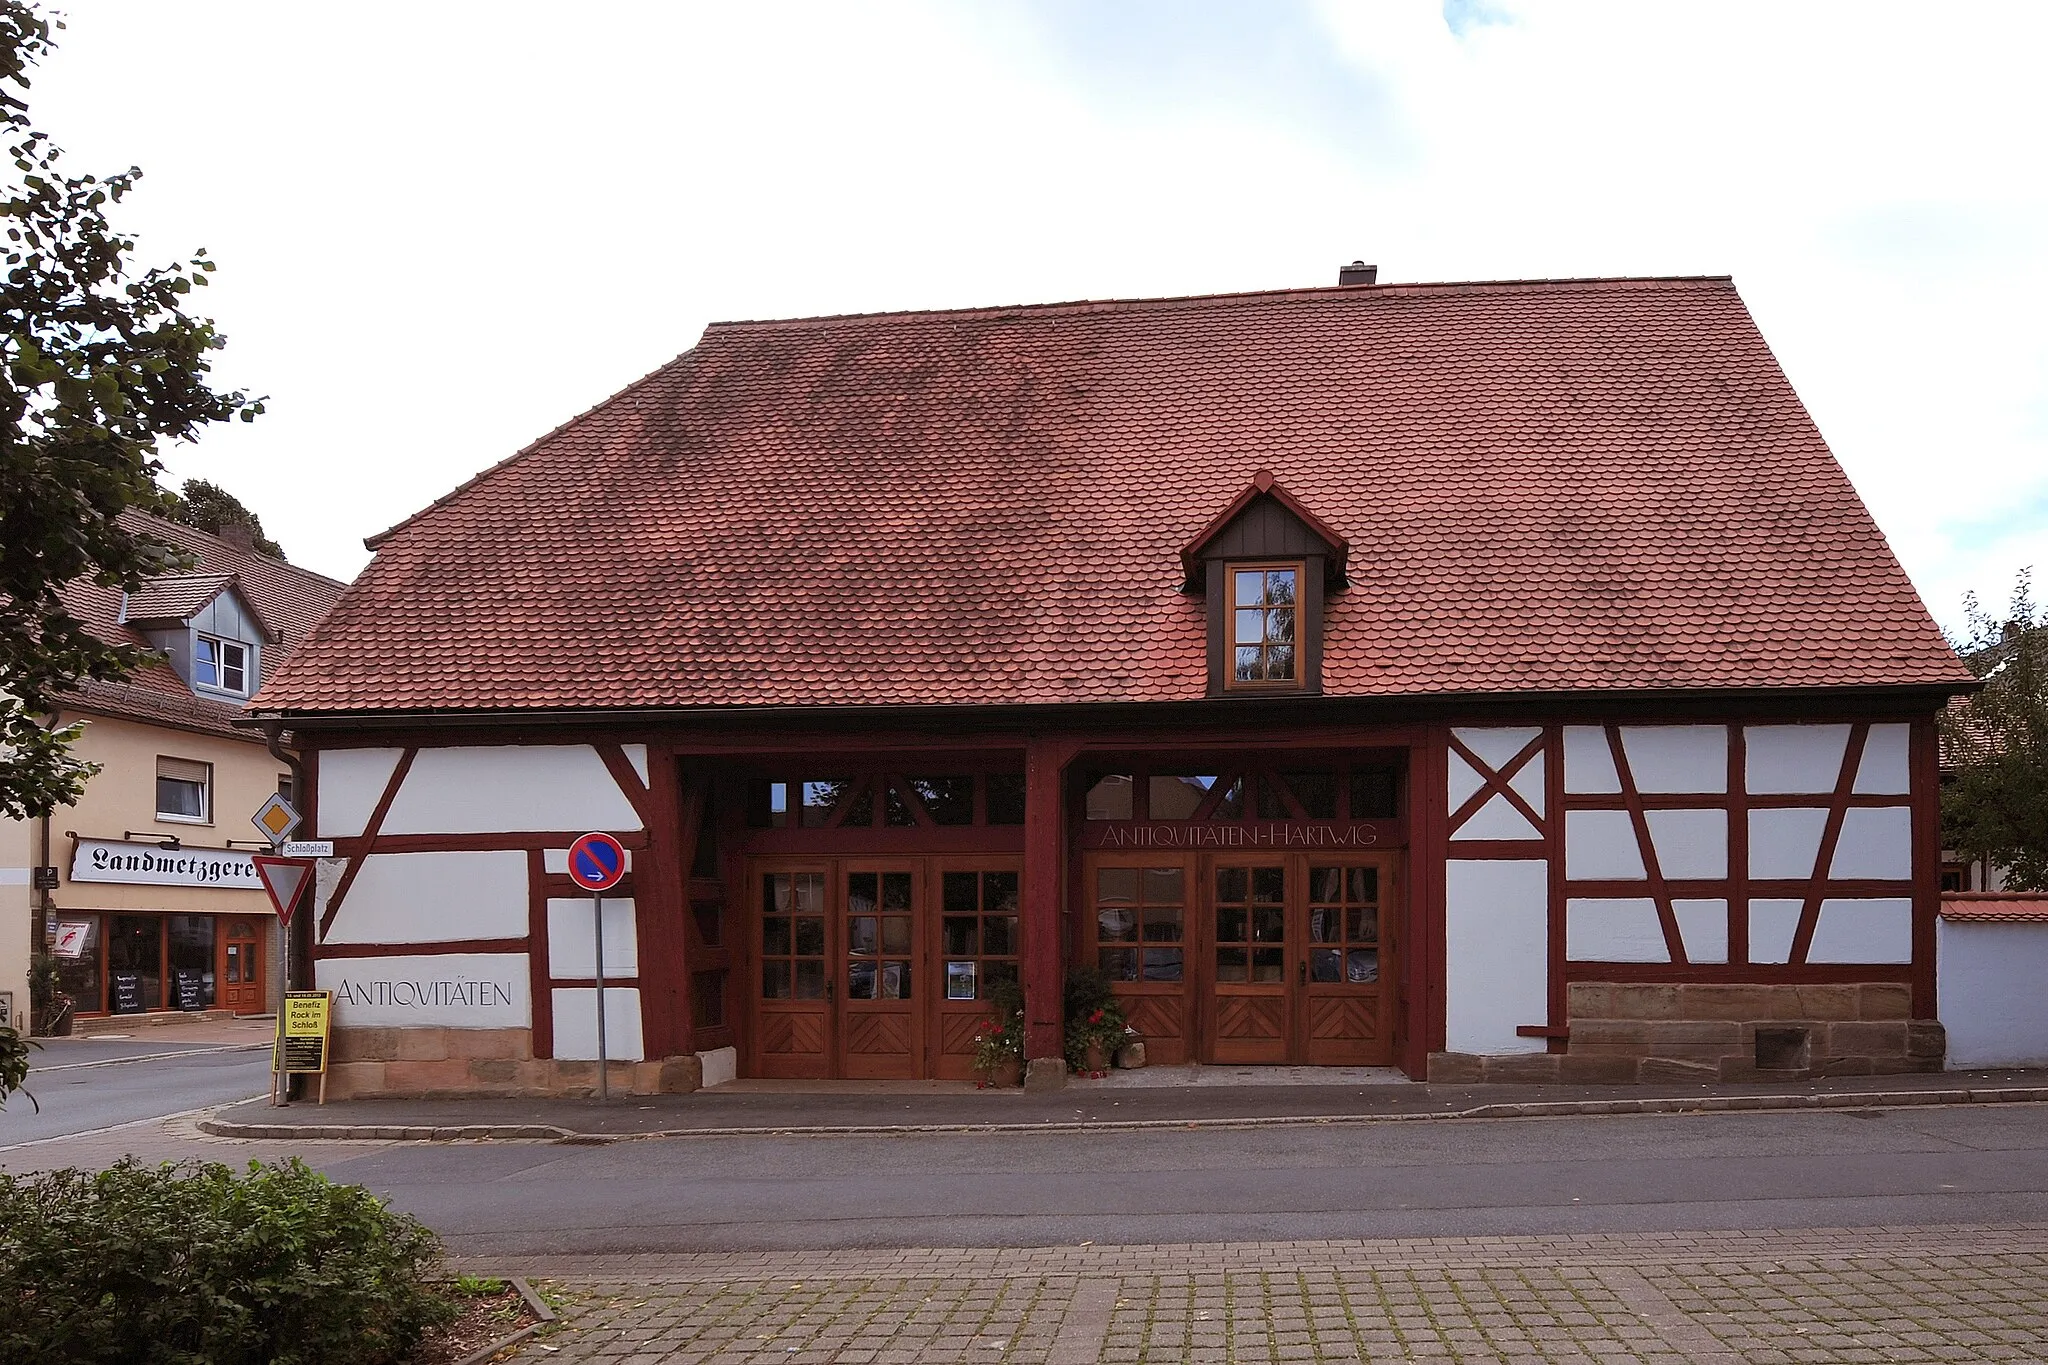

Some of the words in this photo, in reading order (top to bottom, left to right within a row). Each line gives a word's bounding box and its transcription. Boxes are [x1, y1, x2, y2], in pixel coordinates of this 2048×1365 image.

[92, 848, 260, 882] Landmetzgere
[286, 843, 329, 855] Schloßplatz
[333, 975, 511, 1009] ANTIQVITÄTEN
